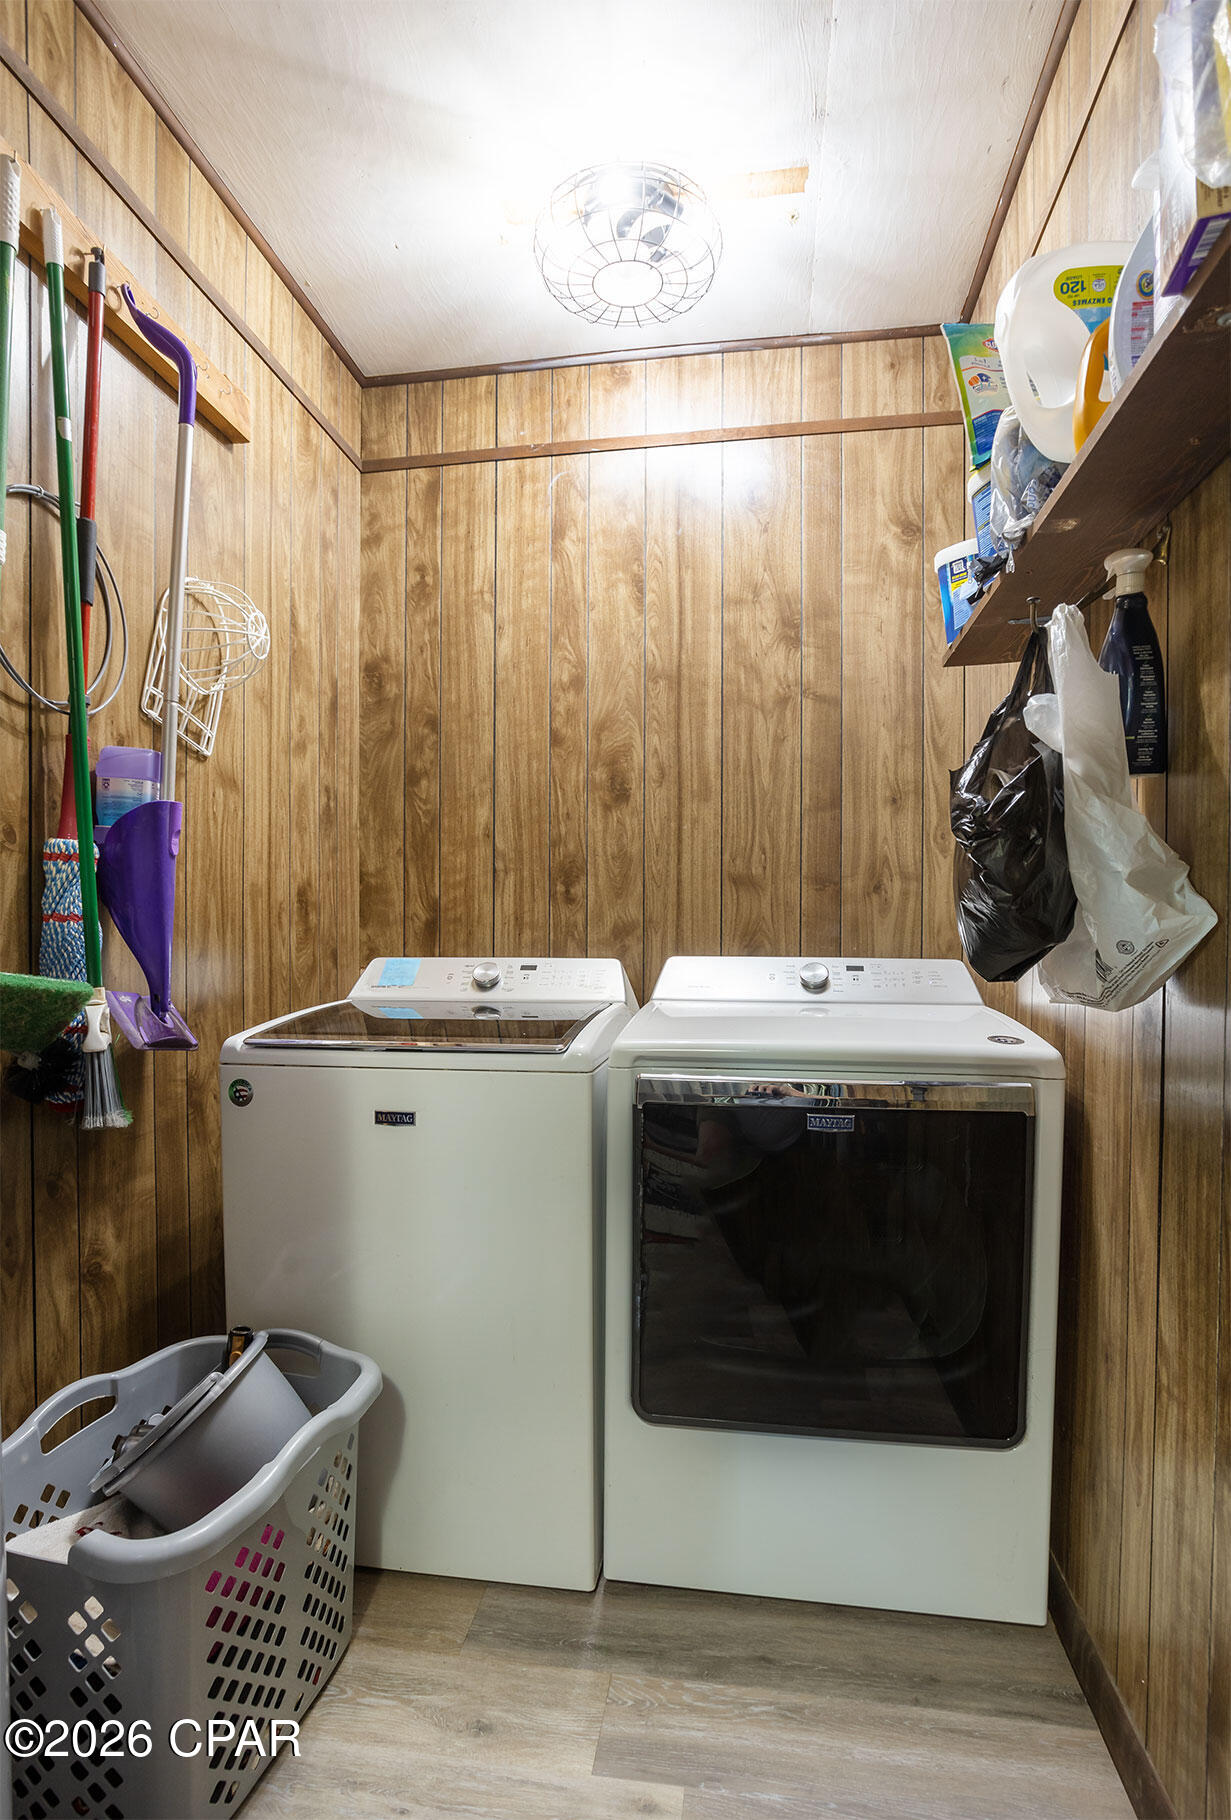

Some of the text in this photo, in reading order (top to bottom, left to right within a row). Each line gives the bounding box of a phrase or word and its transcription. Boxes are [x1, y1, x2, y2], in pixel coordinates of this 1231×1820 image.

[1060, 280, 1087, 295] 120
[1073, 298, 1105, 306] ENZYMES
[377, 1113, 413, 1123] MAYTAG
[810, 1118, 850, 1127] MAYTAG
